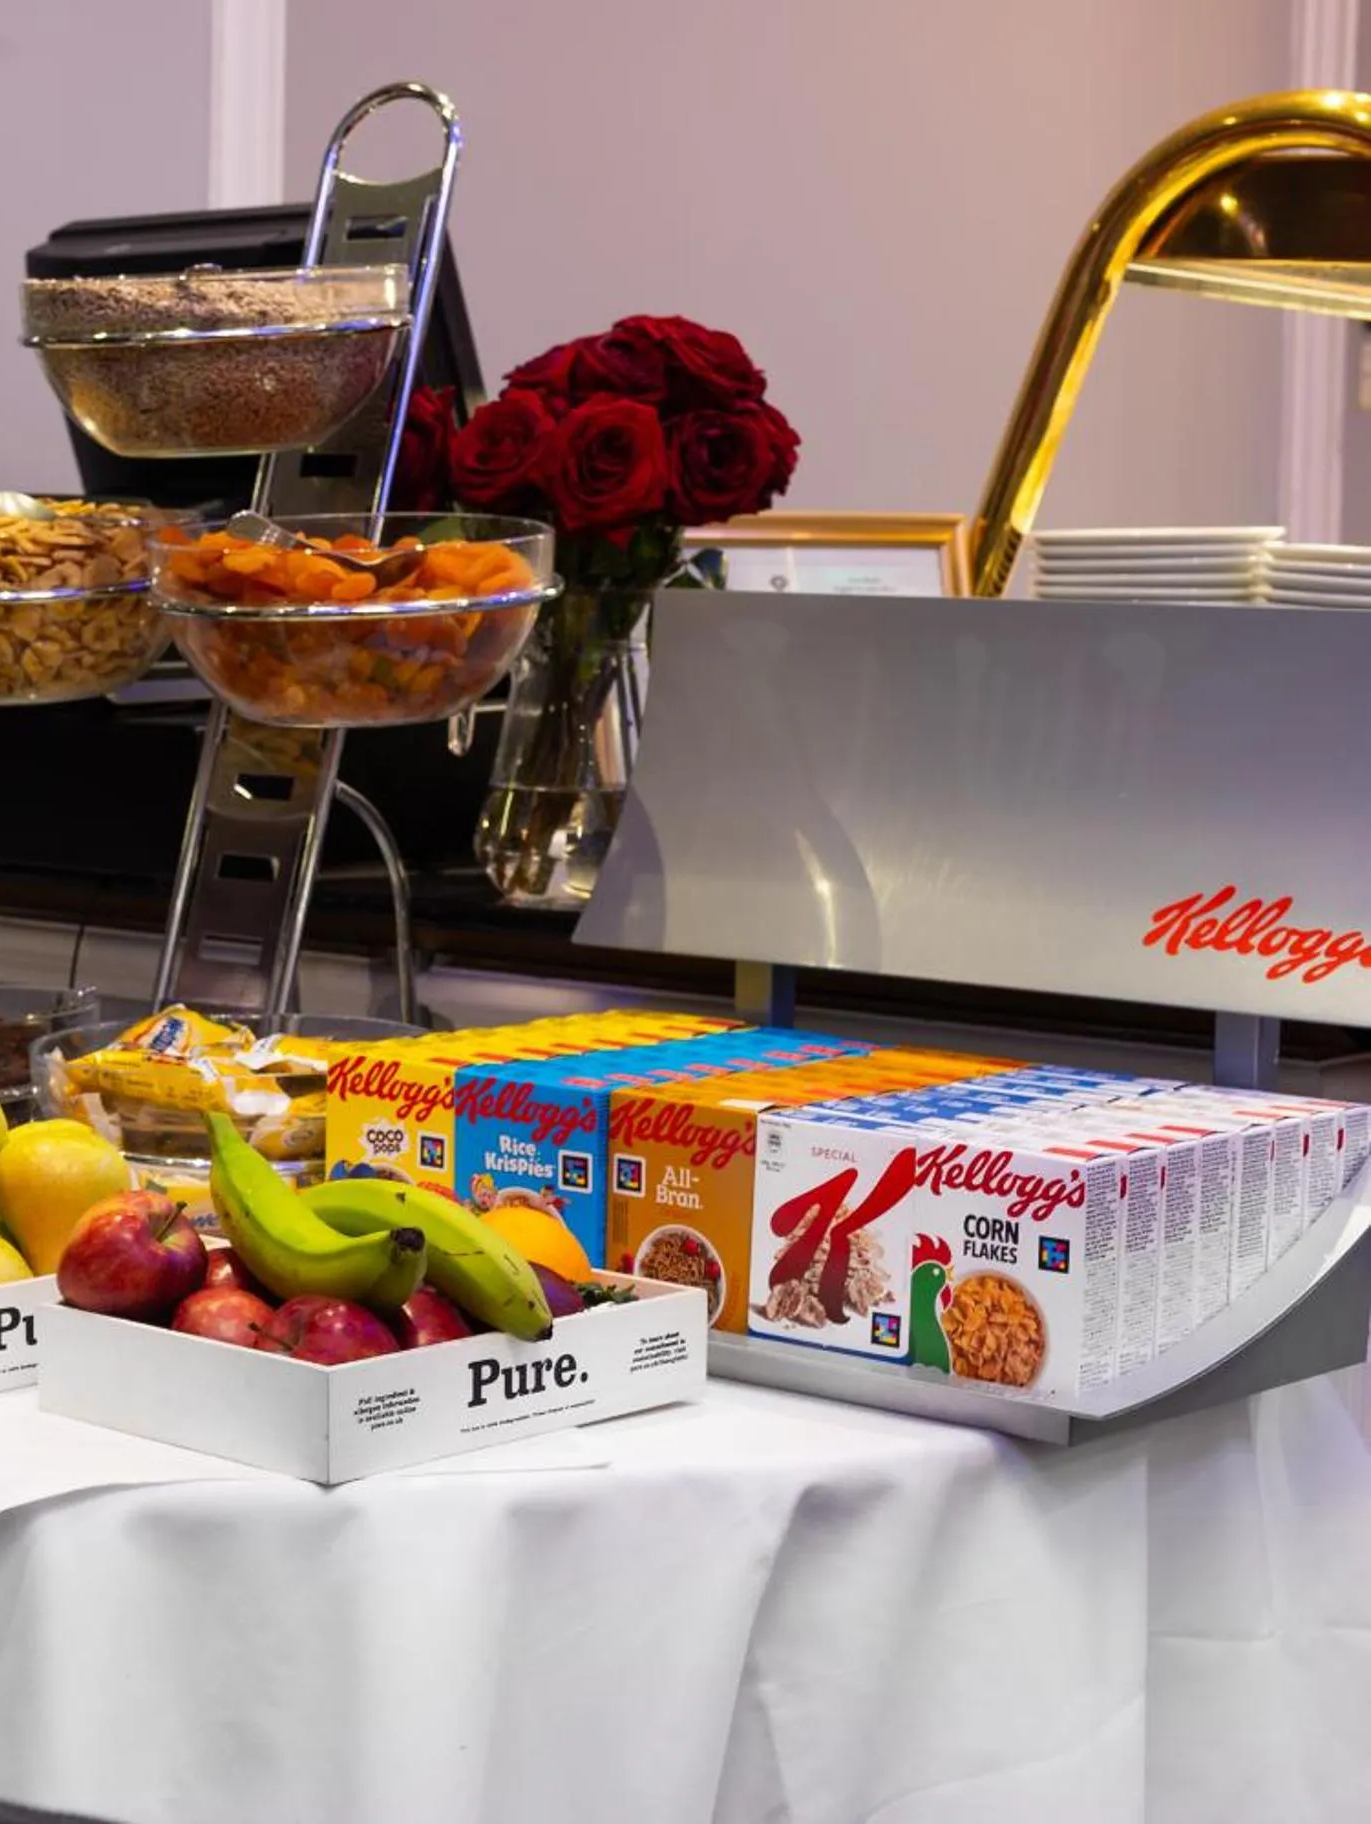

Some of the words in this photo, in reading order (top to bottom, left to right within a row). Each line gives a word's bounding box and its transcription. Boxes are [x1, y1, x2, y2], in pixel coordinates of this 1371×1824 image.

[327, 1056, 454, 1122] Kellogg's
[455, 1077, 597, 1146] Kellogg's
[499, 1134, 536, 1155] Rice
[609, 1098, 756, 1170] Kellogg's
[811, 1145, 858, 1163] SPECIAL
[485, 1151, 554, 1178] Krispies
[662, 1165, 700, 1189] All-
[916, 1144, 1085, 1222] Kellogg's
[769, 1147, 917, 1325] K
[963, 1213, 1020, 1246] CORN
[963, 1242, 1019, 1265] FLAKES
[468, 1353, 589, 1408] Pure.
